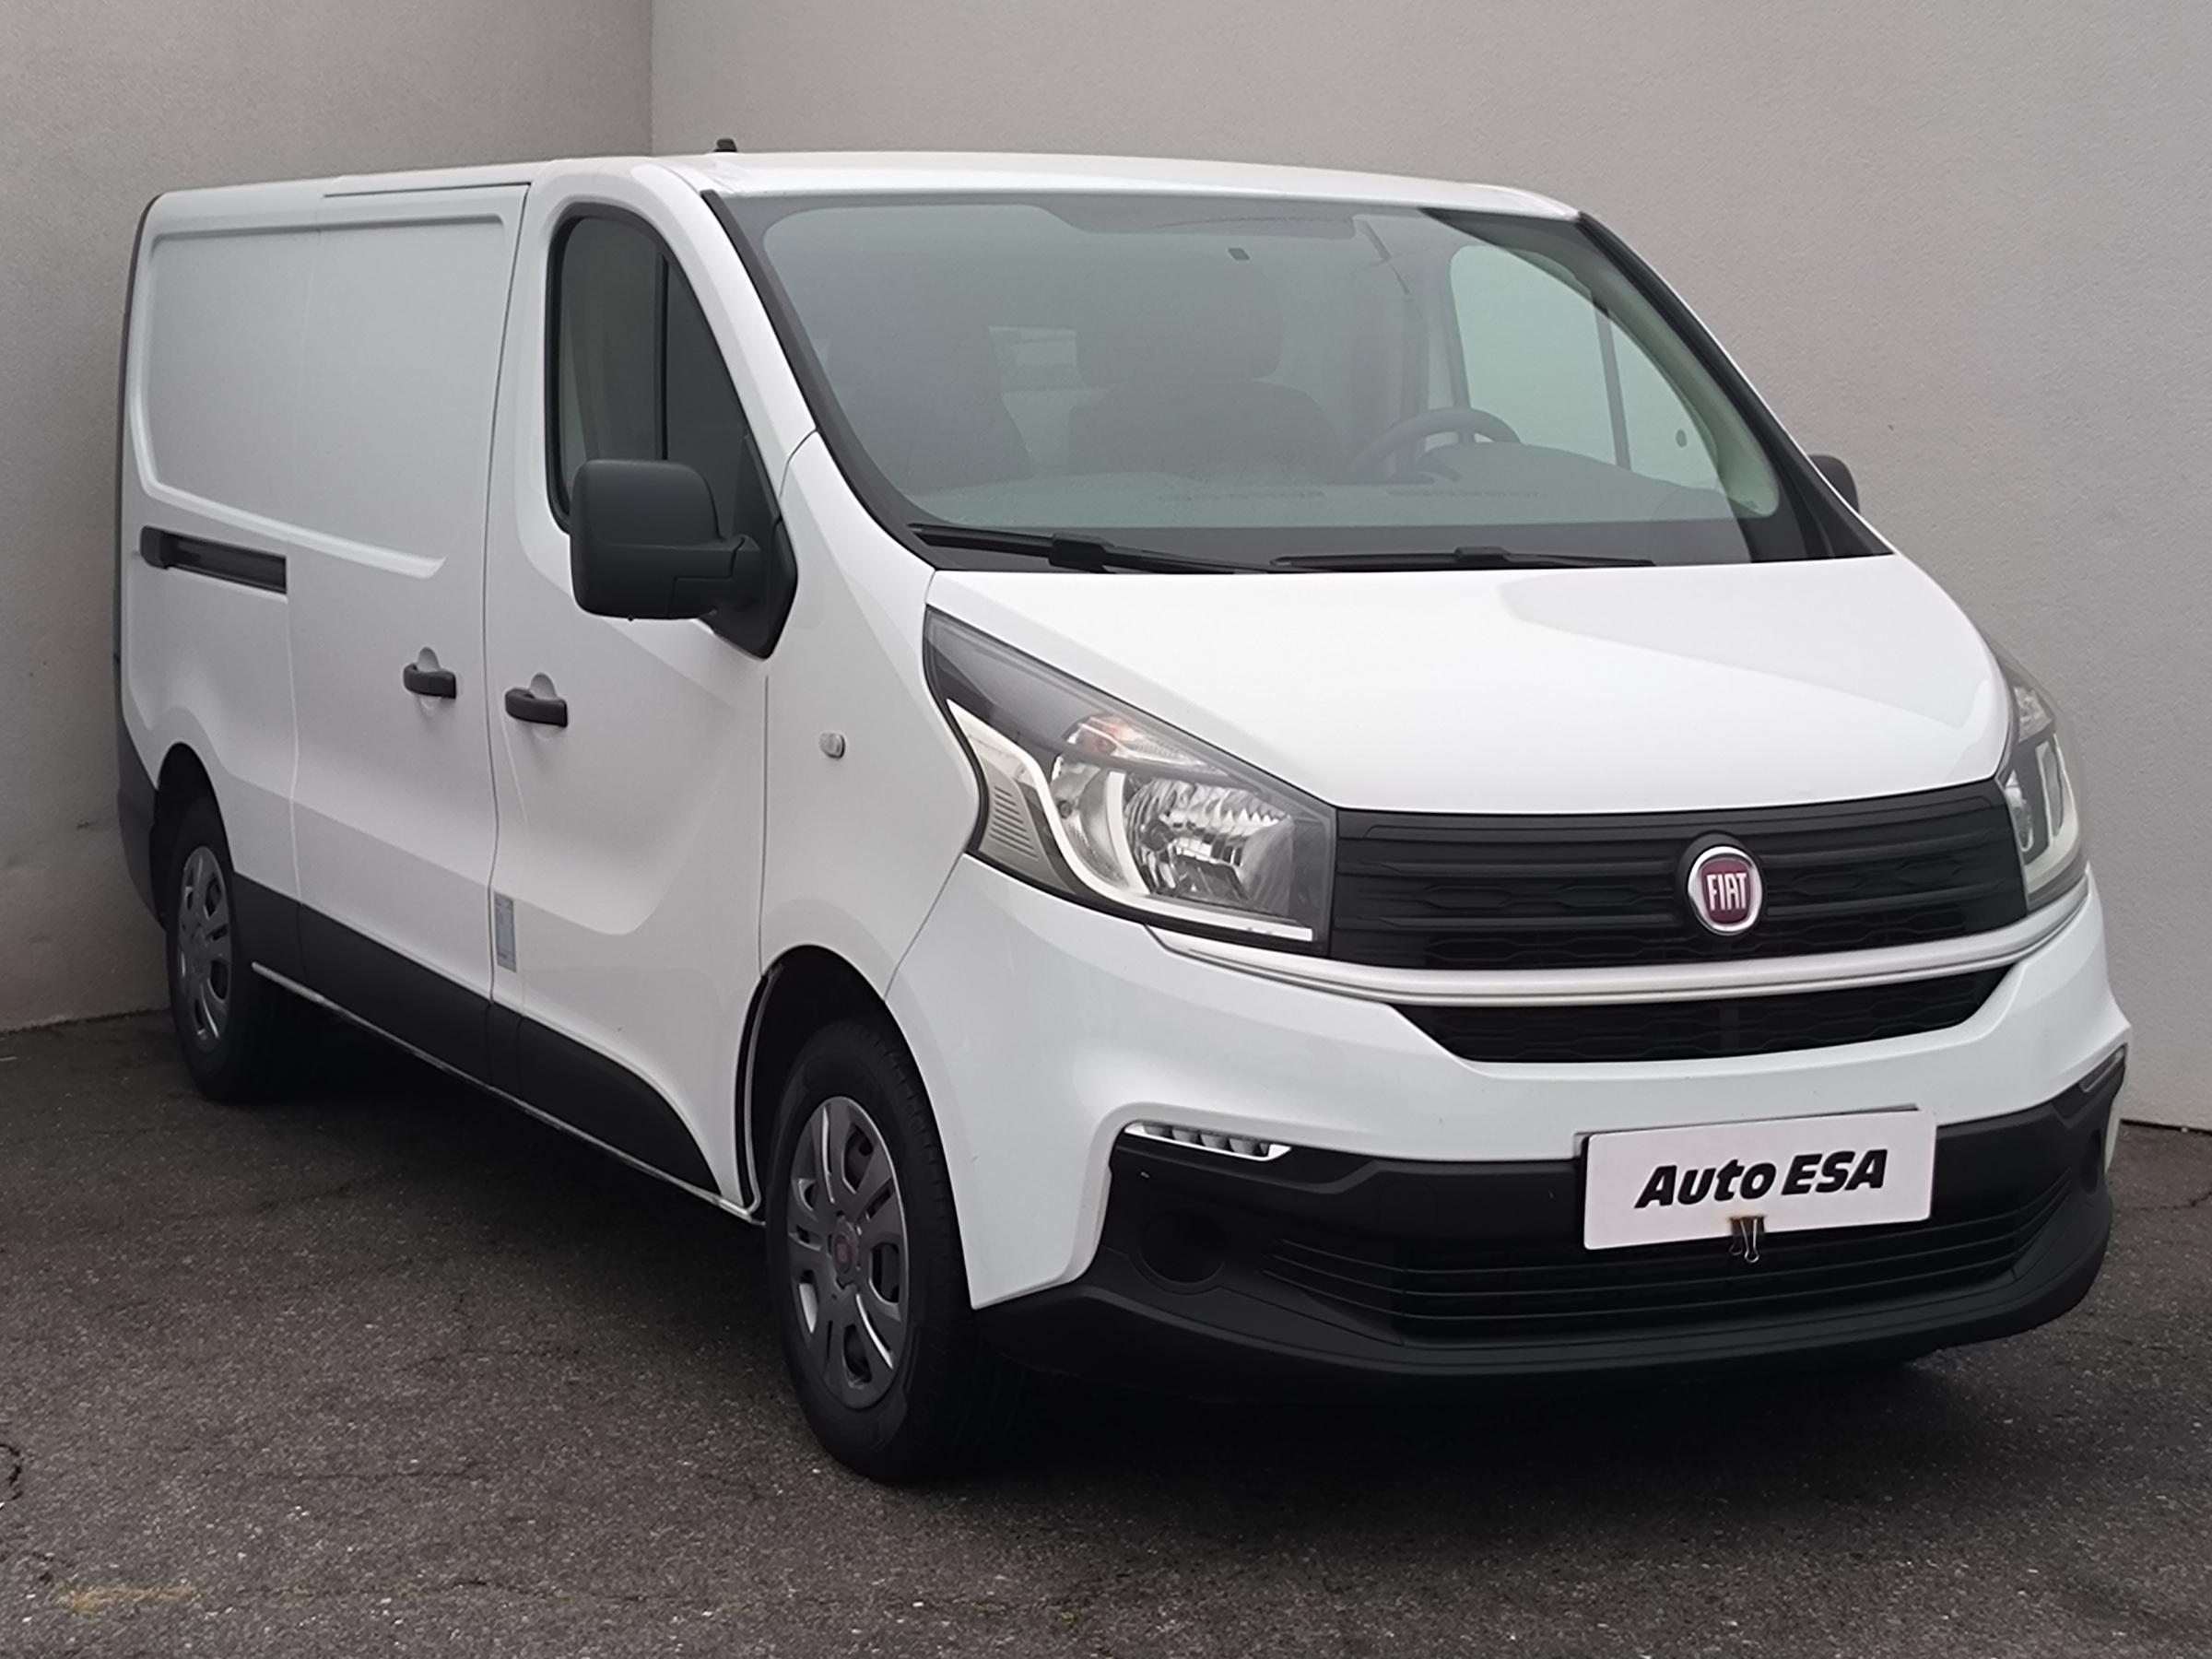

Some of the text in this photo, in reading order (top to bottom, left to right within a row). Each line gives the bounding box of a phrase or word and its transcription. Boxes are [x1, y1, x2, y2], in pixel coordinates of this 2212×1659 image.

[1706, 873, 1747, 911] FIAT
[1634, 1148, 1888, 1208] Auto ESA
